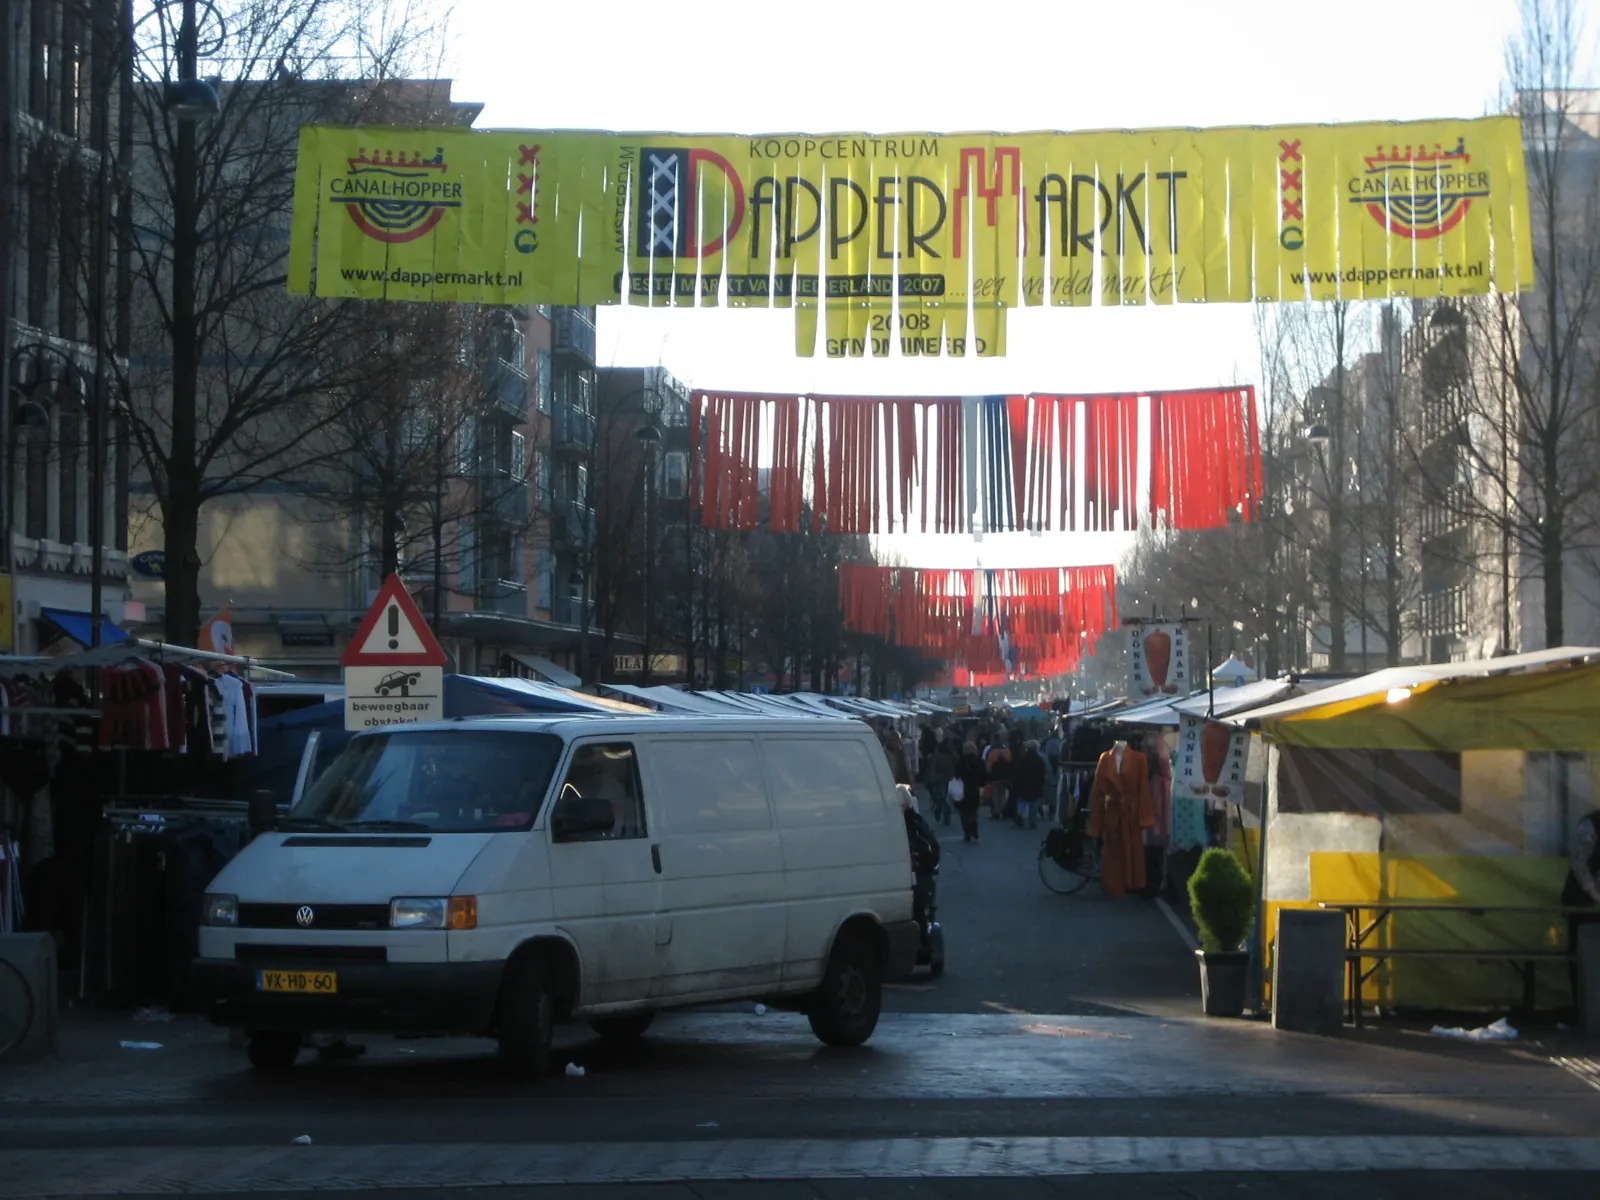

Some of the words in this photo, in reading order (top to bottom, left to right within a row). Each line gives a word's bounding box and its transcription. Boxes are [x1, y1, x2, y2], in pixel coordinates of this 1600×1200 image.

[750, 139, 940, 159] KOOPCENTRUM
[329, 177, 462, 199] CANALHOPPER
[1347, 171, 1489, 194] CANALHOPPER
[341, 266, 523, 288] www.dappermarkt.nl
[1290, 261, 1483, 286] www.dappermarkt.nl
[749, 277, 783, 292] VAN
[903, 277, 941, 292] 2007
[872, 312, 931, 331] 2008
[352, 702, 431, 713] beweegbaar
